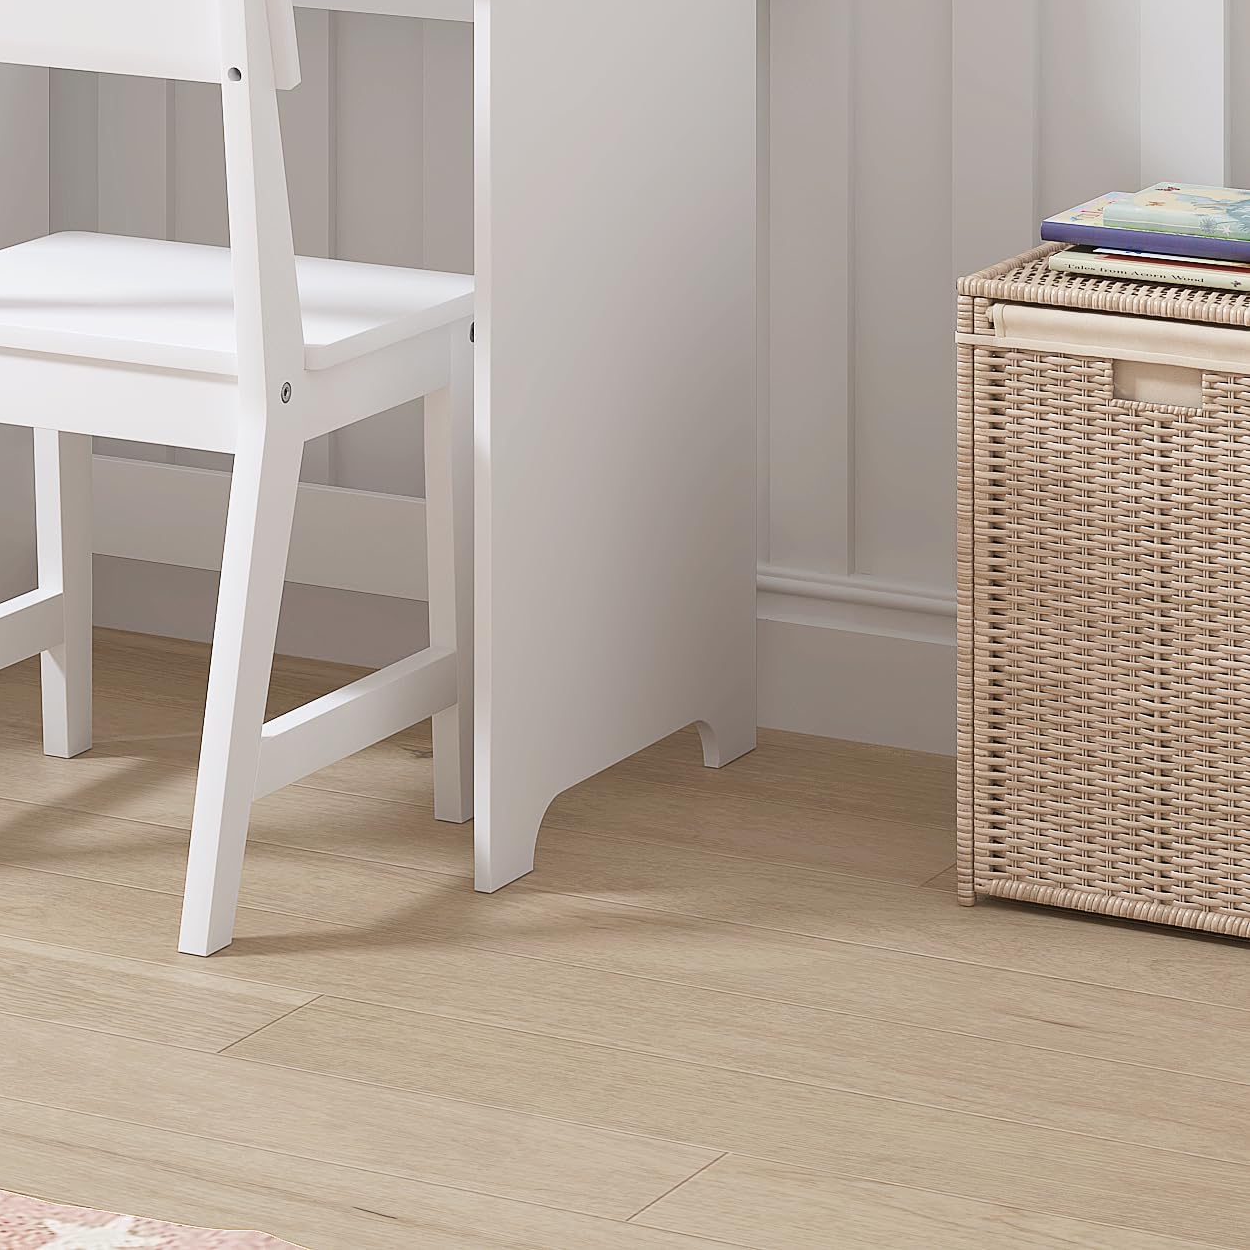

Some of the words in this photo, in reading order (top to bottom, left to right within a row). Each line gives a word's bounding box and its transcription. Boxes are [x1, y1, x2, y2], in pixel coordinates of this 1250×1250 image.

[1065, 264, 1096, 272] Tales
[1100, 267, 1127, 276] from
[1131, 270, 1166, 279] Acorn
[1172, 274, 1205, 283] Wood
